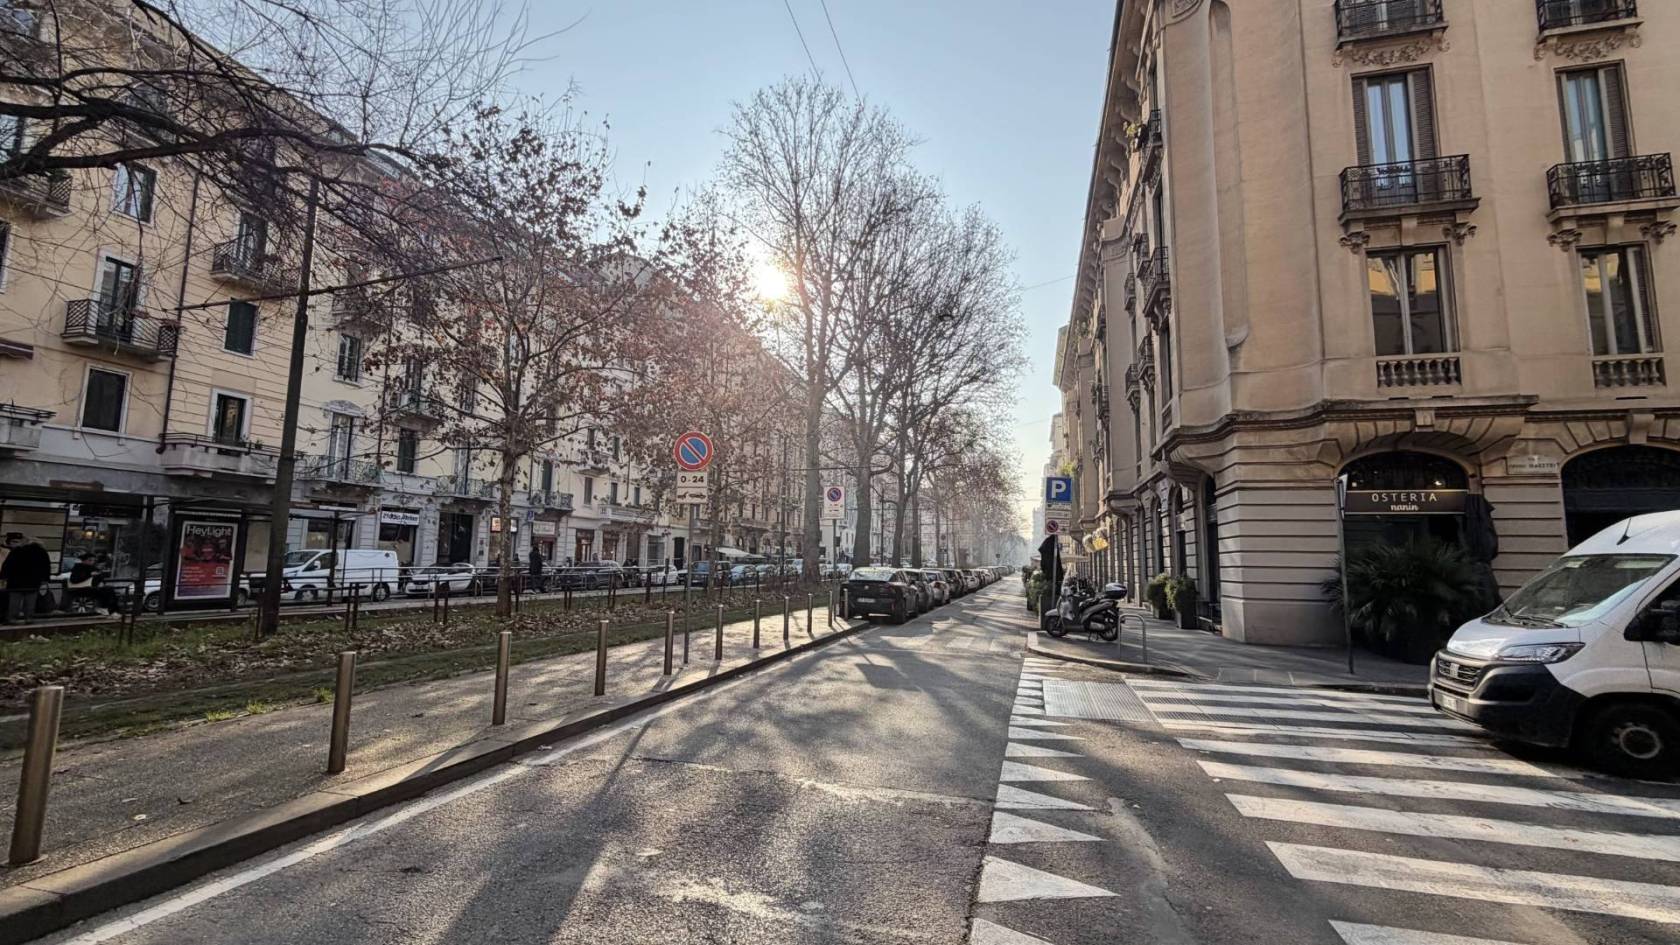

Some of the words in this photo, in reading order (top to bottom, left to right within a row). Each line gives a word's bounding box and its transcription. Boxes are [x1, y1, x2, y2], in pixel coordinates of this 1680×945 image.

[1051, 480, 1066, 498] P
[1371, 492, 1437, 502] OSTERIA
[1390, 502, 1419, 511] nanin
[186, 525, 232, 537] HeyLight
